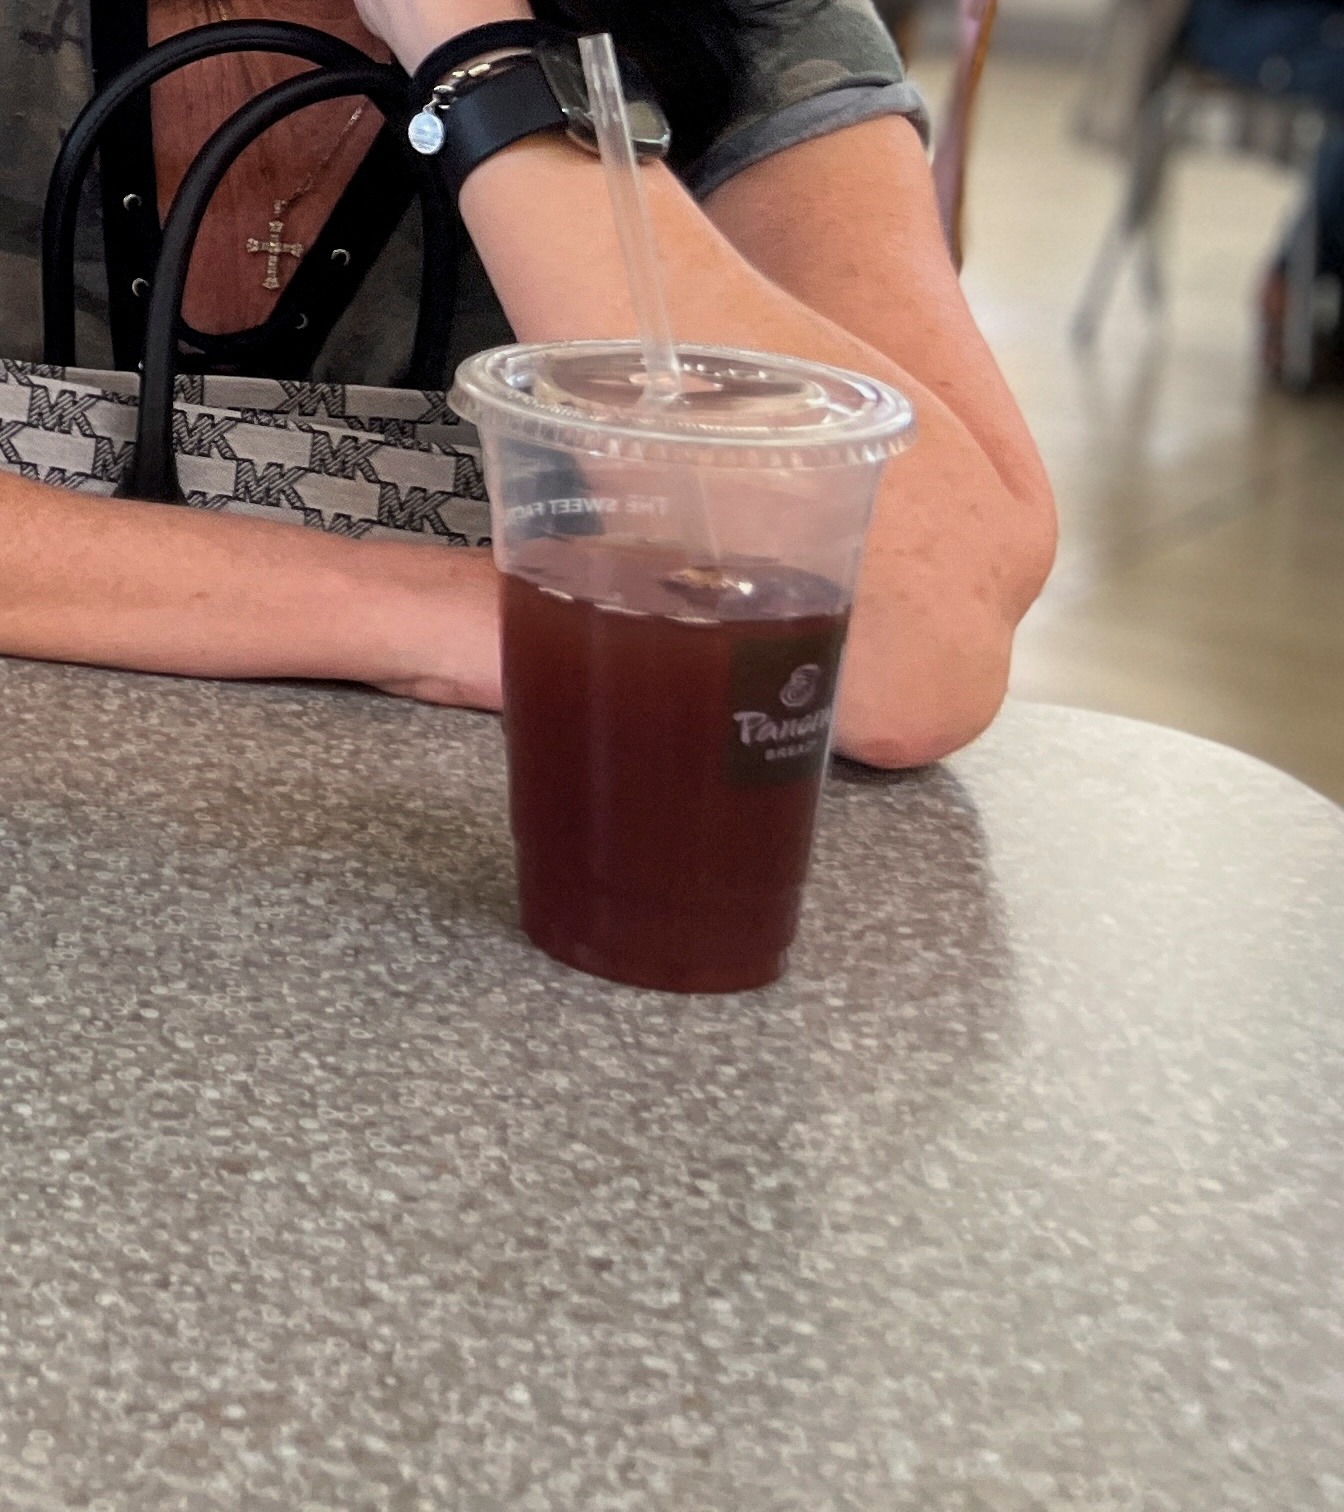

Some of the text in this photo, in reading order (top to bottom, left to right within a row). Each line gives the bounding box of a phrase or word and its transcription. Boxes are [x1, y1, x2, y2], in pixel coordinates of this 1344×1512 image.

[29, 385, 99, 437] MK
[172, 409, 238, 459] MK
[234, 457, 308, 509] MK
[311, 431, 383, 484] MK
[377, 481, 454, 535] MK
